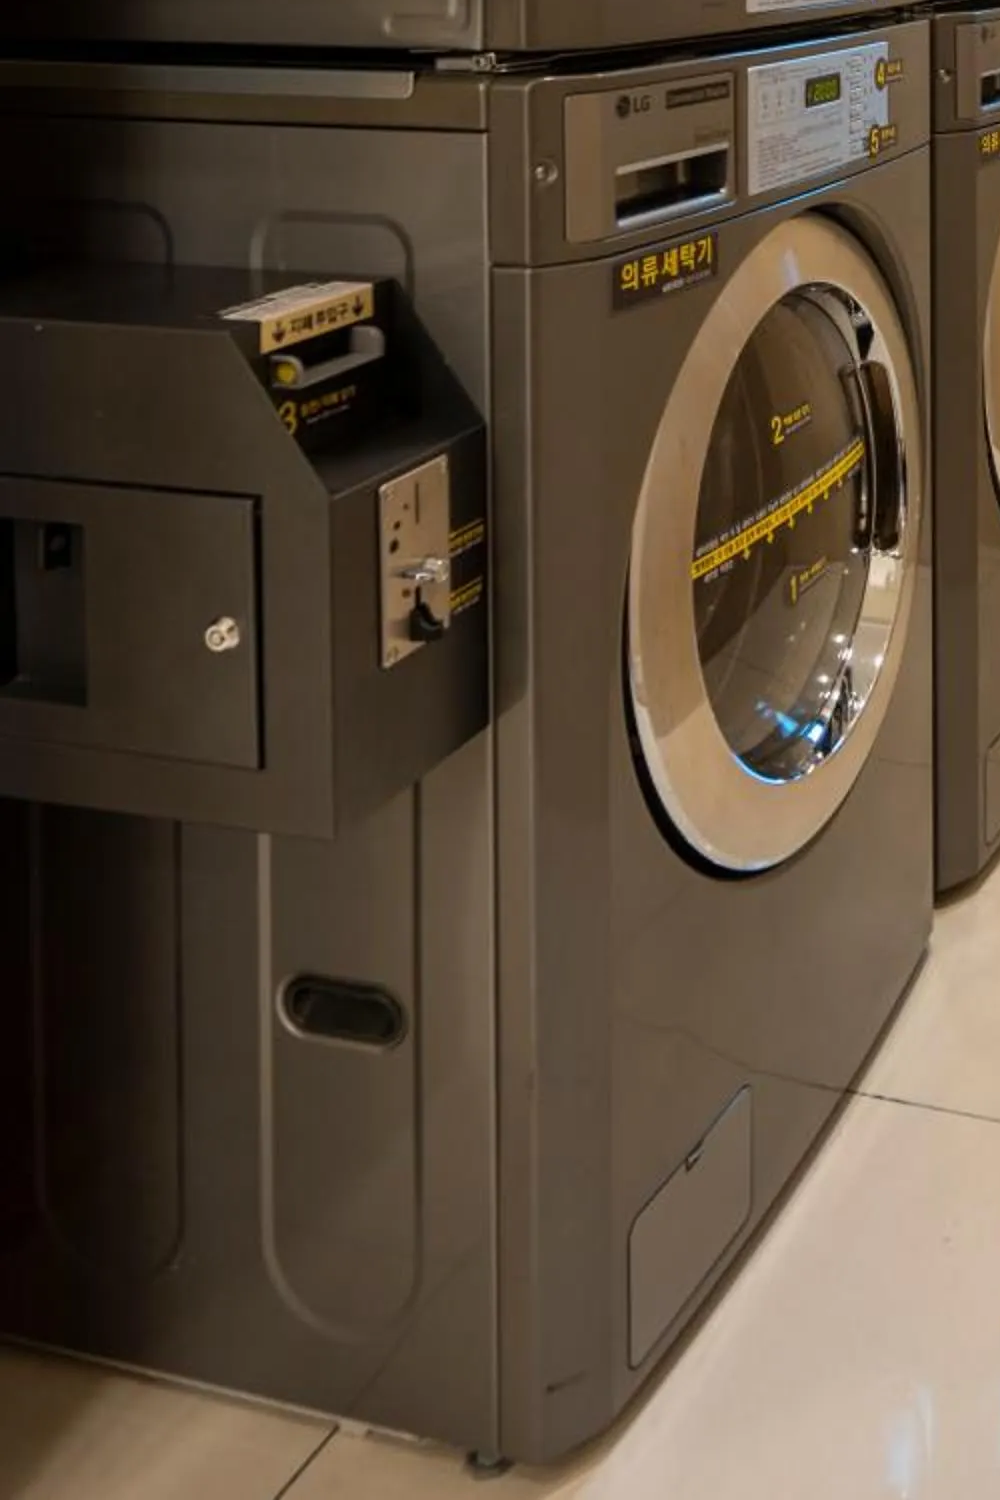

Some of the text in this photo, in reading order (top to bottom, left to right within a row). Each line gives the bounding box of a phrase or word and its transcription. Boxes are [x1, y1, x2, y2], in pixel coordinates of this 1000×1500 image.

[632, 94, 651, 114] LG
[620, 235, 713, 291] 의류세탁기
[771, 415, 785, 445] 2
